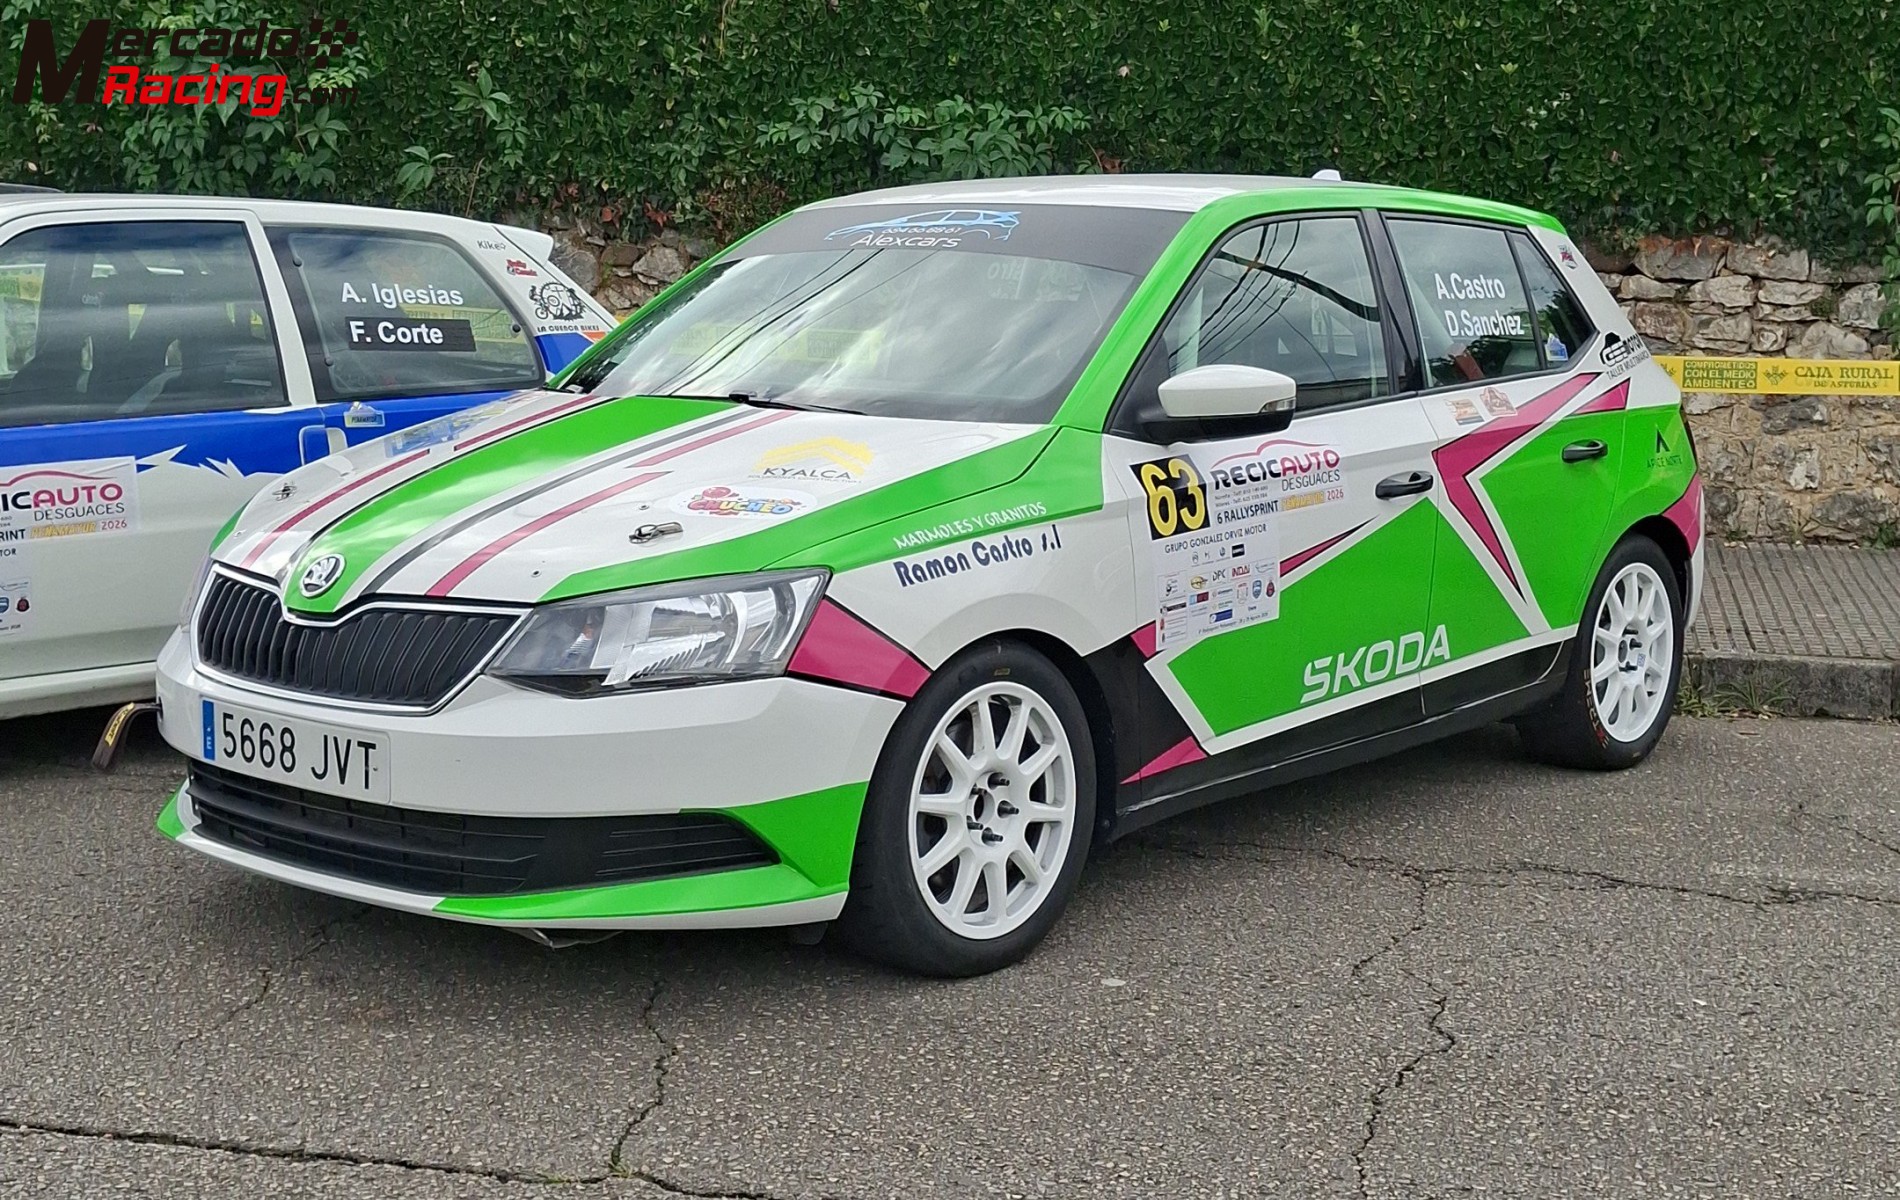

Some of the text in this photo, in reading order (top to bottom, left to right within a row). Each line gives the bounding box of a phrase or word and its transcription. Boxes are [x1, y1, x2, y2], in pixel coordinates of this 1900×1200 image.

[850, 234, 962, 248] Alexcars
[341, 283, 464, 308] A. Iglesias
[1434, 273, 1506, 300] A.Castro
[350, 321, 444, 344] F. Corte
[1444, 309, 1525, 337] D.Sanchez
[1685, 361, 1757, 370] COMPROMETIDOS
[1685, 370, 1756, 379] CON EL MEDIO
[1794, 366, 1894, 380] CAJA RURAL
[1684, 379, 1748, 389] AMBIENTE
[762, 467, 852, 480] KYALCA
[1210, 449, 1341, 491] RECICAUTO
[1281, 469, 1341, 492] DESGUACES
[687, 498, 794, 515] CHUCHEO
[1140, 458, 1206, 537] 63
[1216, 512, 1224, 524] 6
[1224, 500, 1279, 524] RALLYSPRINT
[1327, 488, 1345, 501] 2026
[34, 502, 126, 522] DESGUACES
[101, 520, 128, 531] 2026
[893, 501, 1047, 550] MARMOLES Y GRANITOS
[1164, 524, 1267, 554] GRUPO GONZALEZ ORVIZ MOTOR
[893, 551, 972, 588] Ramon
[971, 535, 1033, 567] Castro
[1300, 624, 1450, 704] SKODA
[222, 712, 377, 790] 5668 JVT
